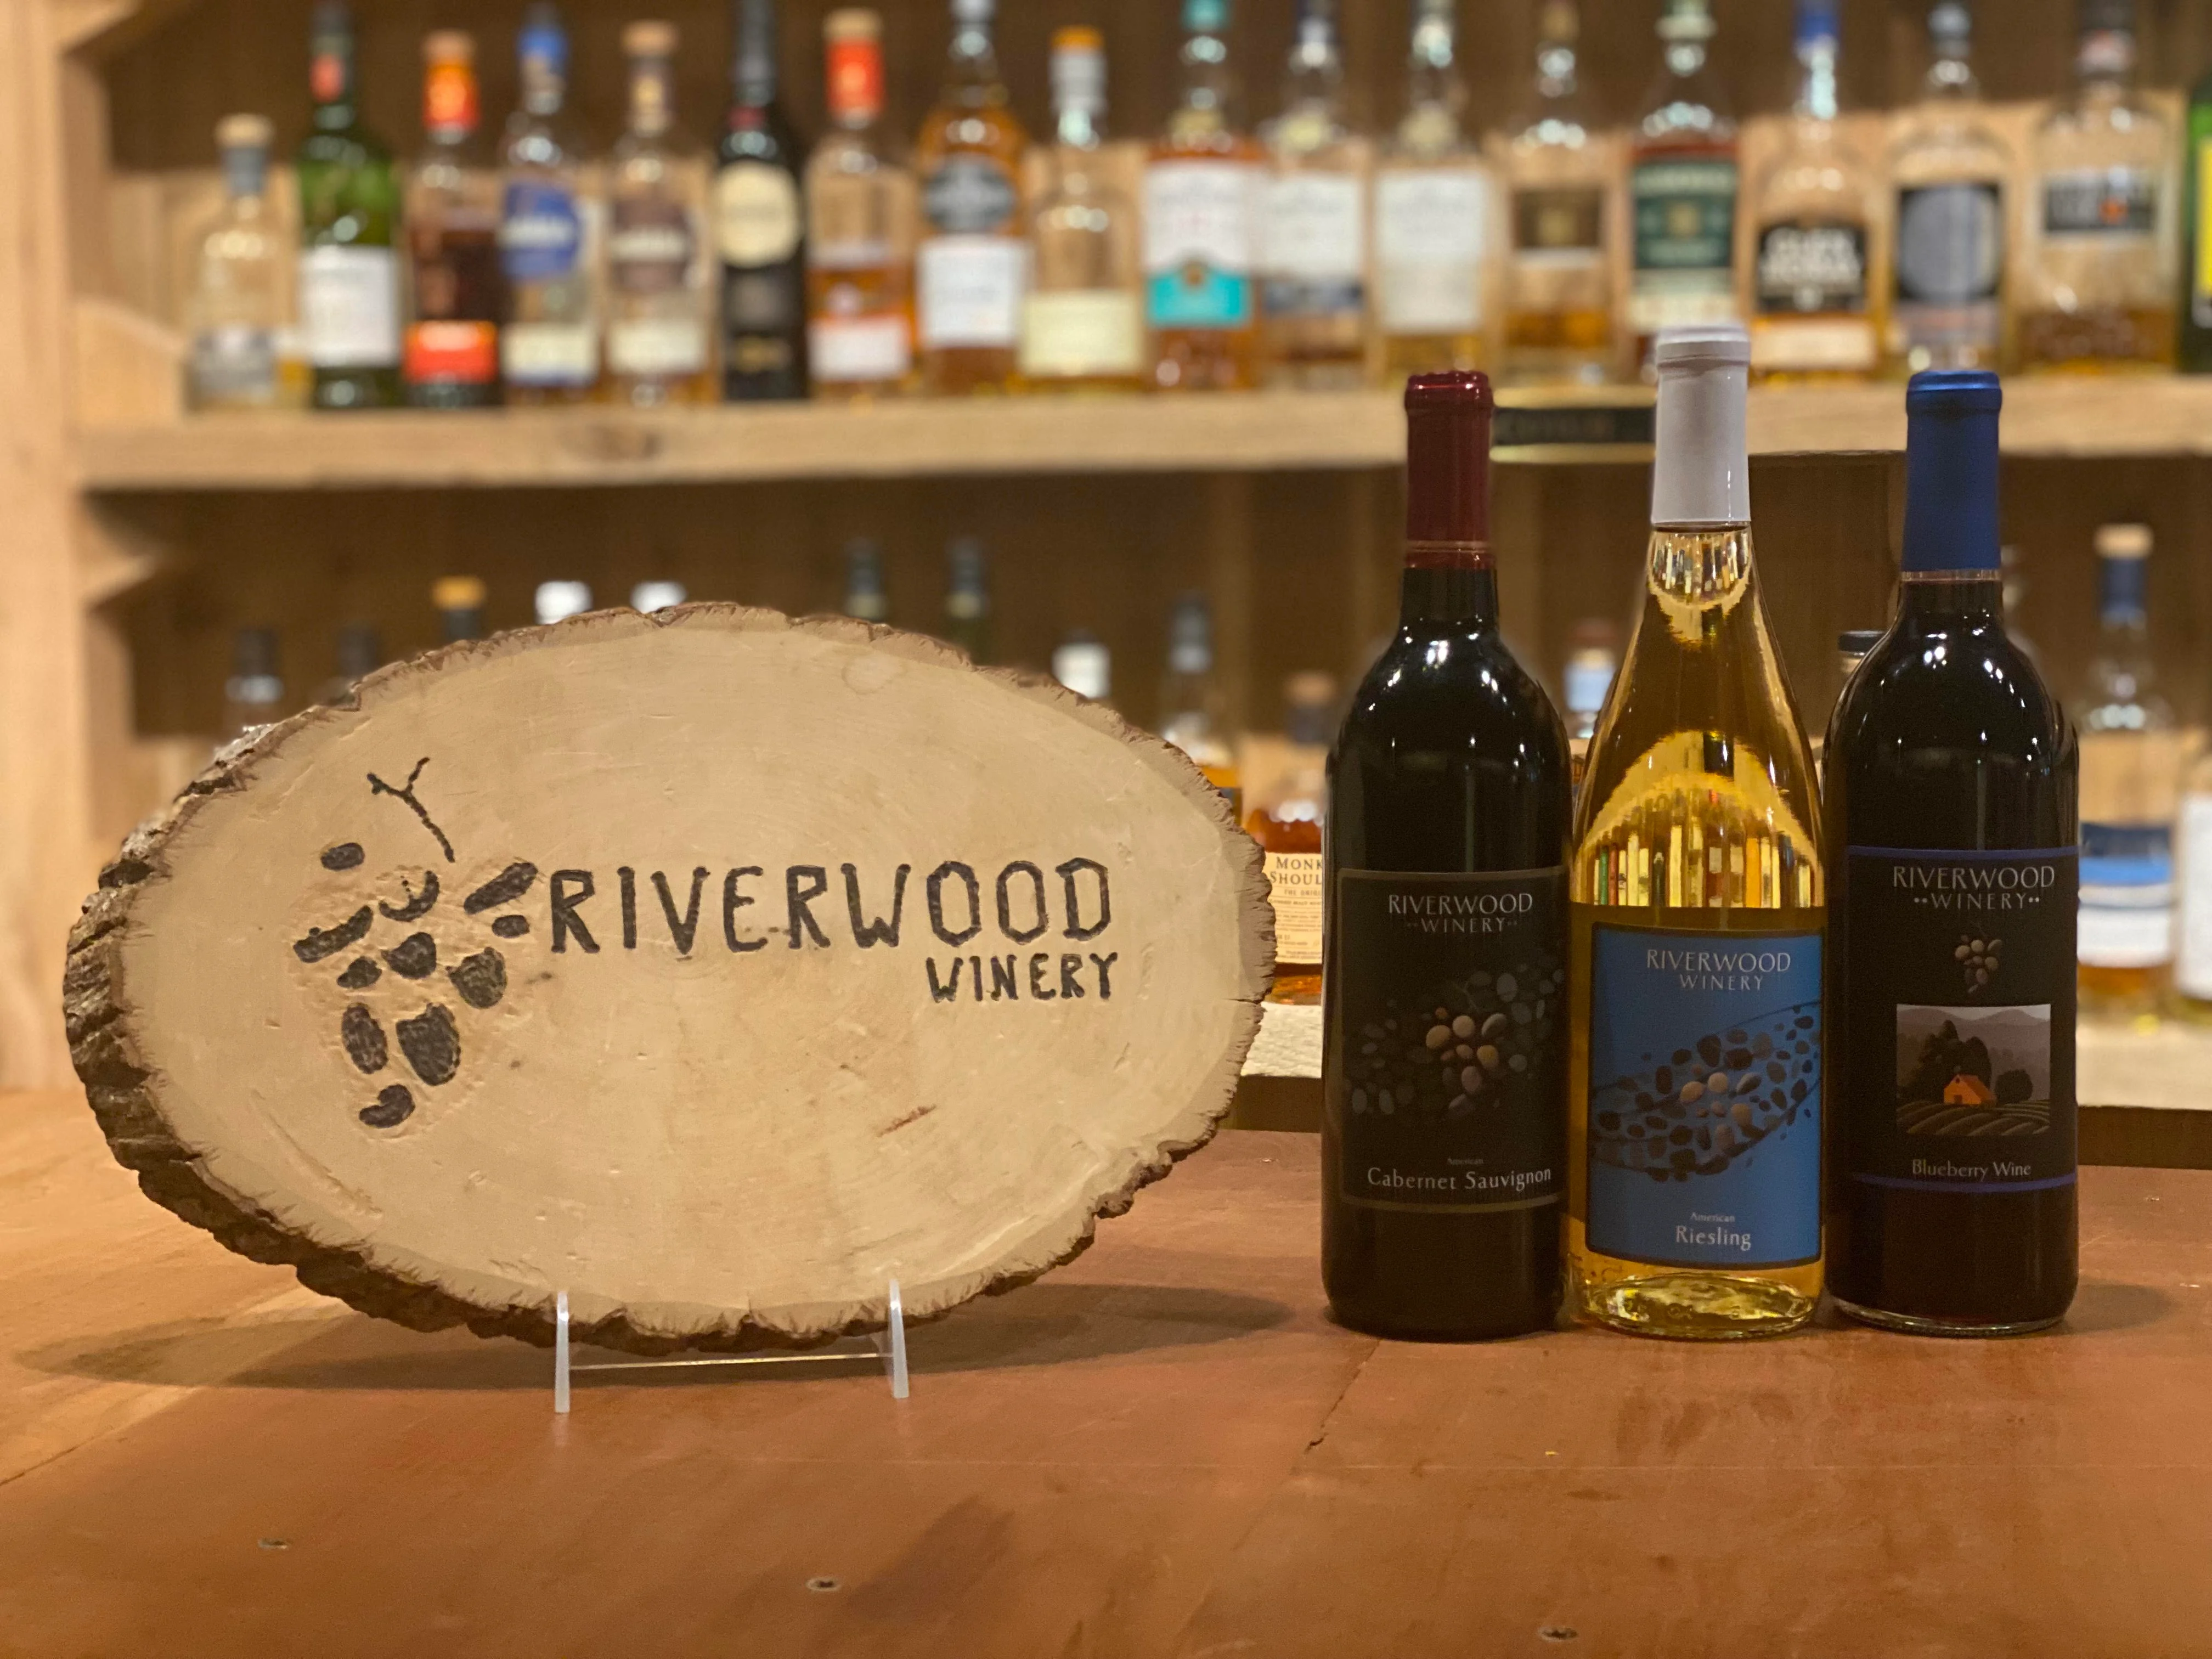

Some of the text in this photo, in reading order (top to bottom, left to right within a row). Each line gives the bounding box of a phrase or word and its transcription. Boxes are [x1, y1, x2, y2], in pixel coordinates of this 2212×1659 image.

[1893, 866, 2055, 889] RIVERWOOD
[550, 857, 1112, 955] RIVERWOOD
[1389, 893, 1533, 915] RIVERWOOD
[1931, 893, 2027, 910] WINERY
[1420, 917, 1505, 933] WINERY
[1647, 949, 1791, 973] RIVERWOOD
[926, 951, 1118, 1003] WINERY
[1679, 974, 1763, 991] WINERY
[1367, 1167, 1551, 1192] Cabernet Sauvignon
[1912, 1159, 2031, 1182] Blueberry Wine
[1690, 1211, 1736, 1222] American
[1675, 1225, 1752, 1251] Riesling
